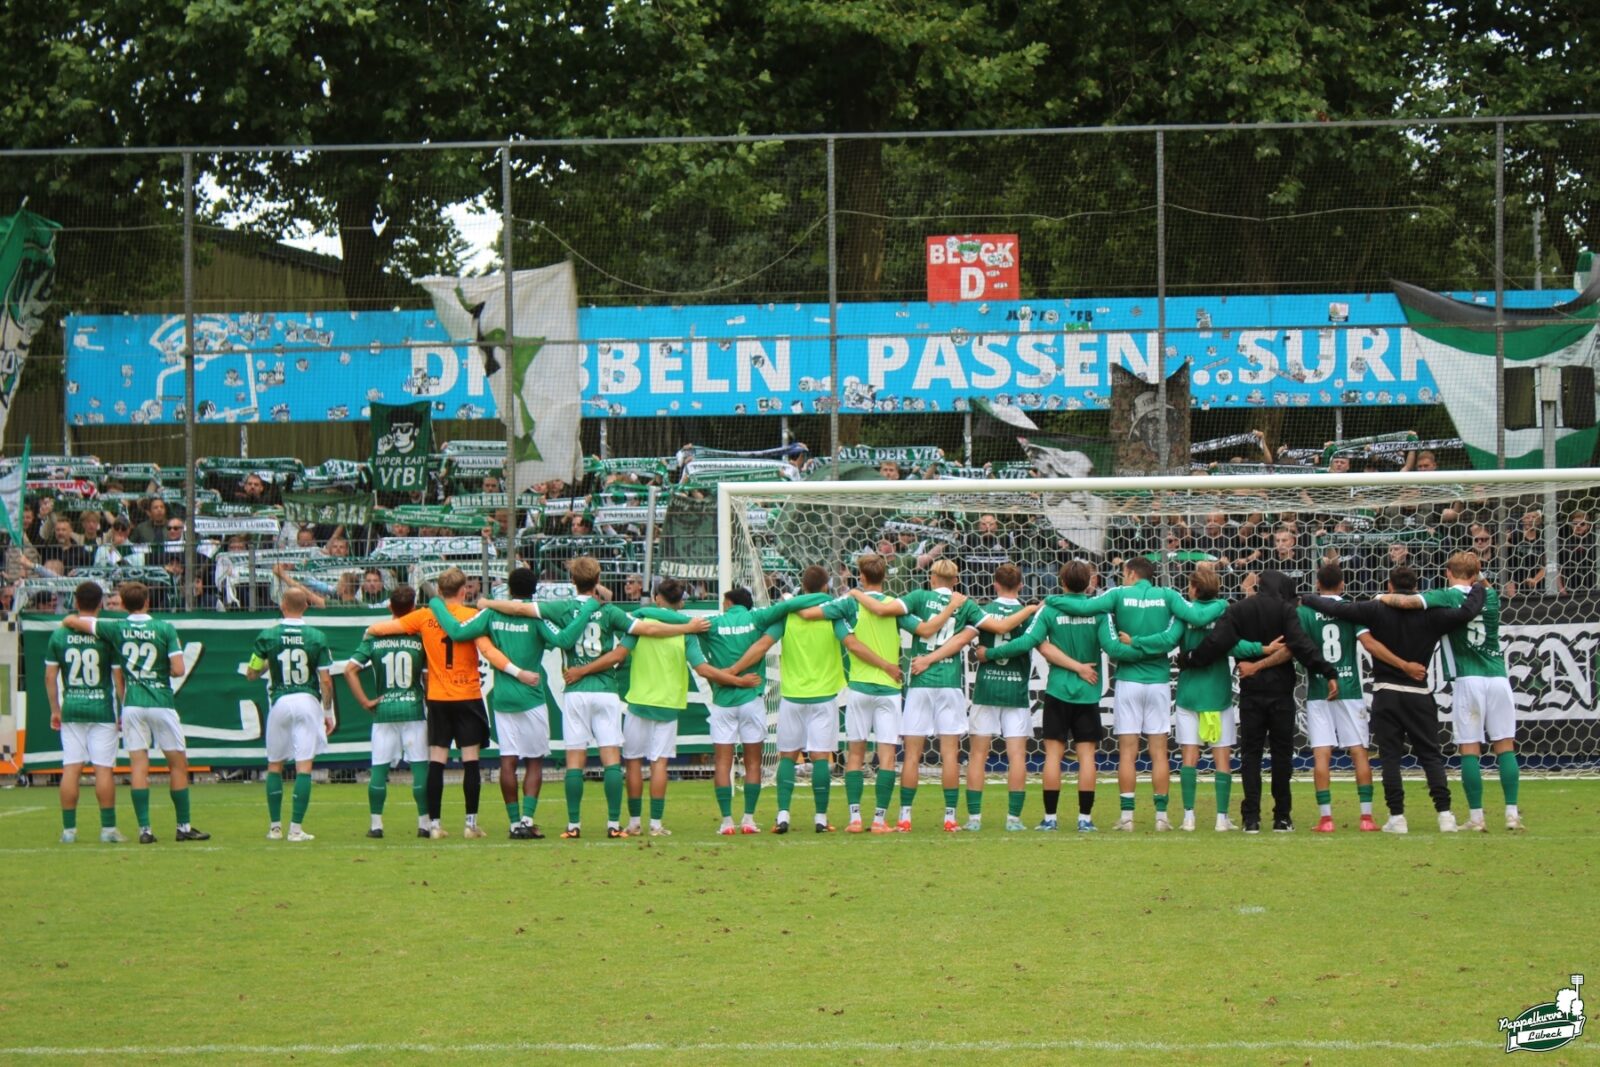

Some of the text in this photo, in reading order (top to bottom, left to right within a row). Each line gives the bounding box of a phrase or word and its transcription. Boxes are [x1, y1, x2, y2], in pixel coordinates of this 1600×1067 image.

[961, 267, 985, 299] D
[840, 448, 870, 460] NUR
[875, 448, 907, 460] DER
[660, 560, 718, 578] SUBKUL
[67, 635, 96, 645] DEMIR
[123, 629, 156, 639] ULRICH
[281, 635, 304, 645] THIEL
[1322, 623, 1342, 663] 8
[1467, 615, 1486, 646] 5
[65, 647, 100, 687] 28
[122, 641, 158, 678] 22
[277, 648, 310, 685] 13
[441, 635, 454, 669] 1
[381, 651, 413, 688] 10
